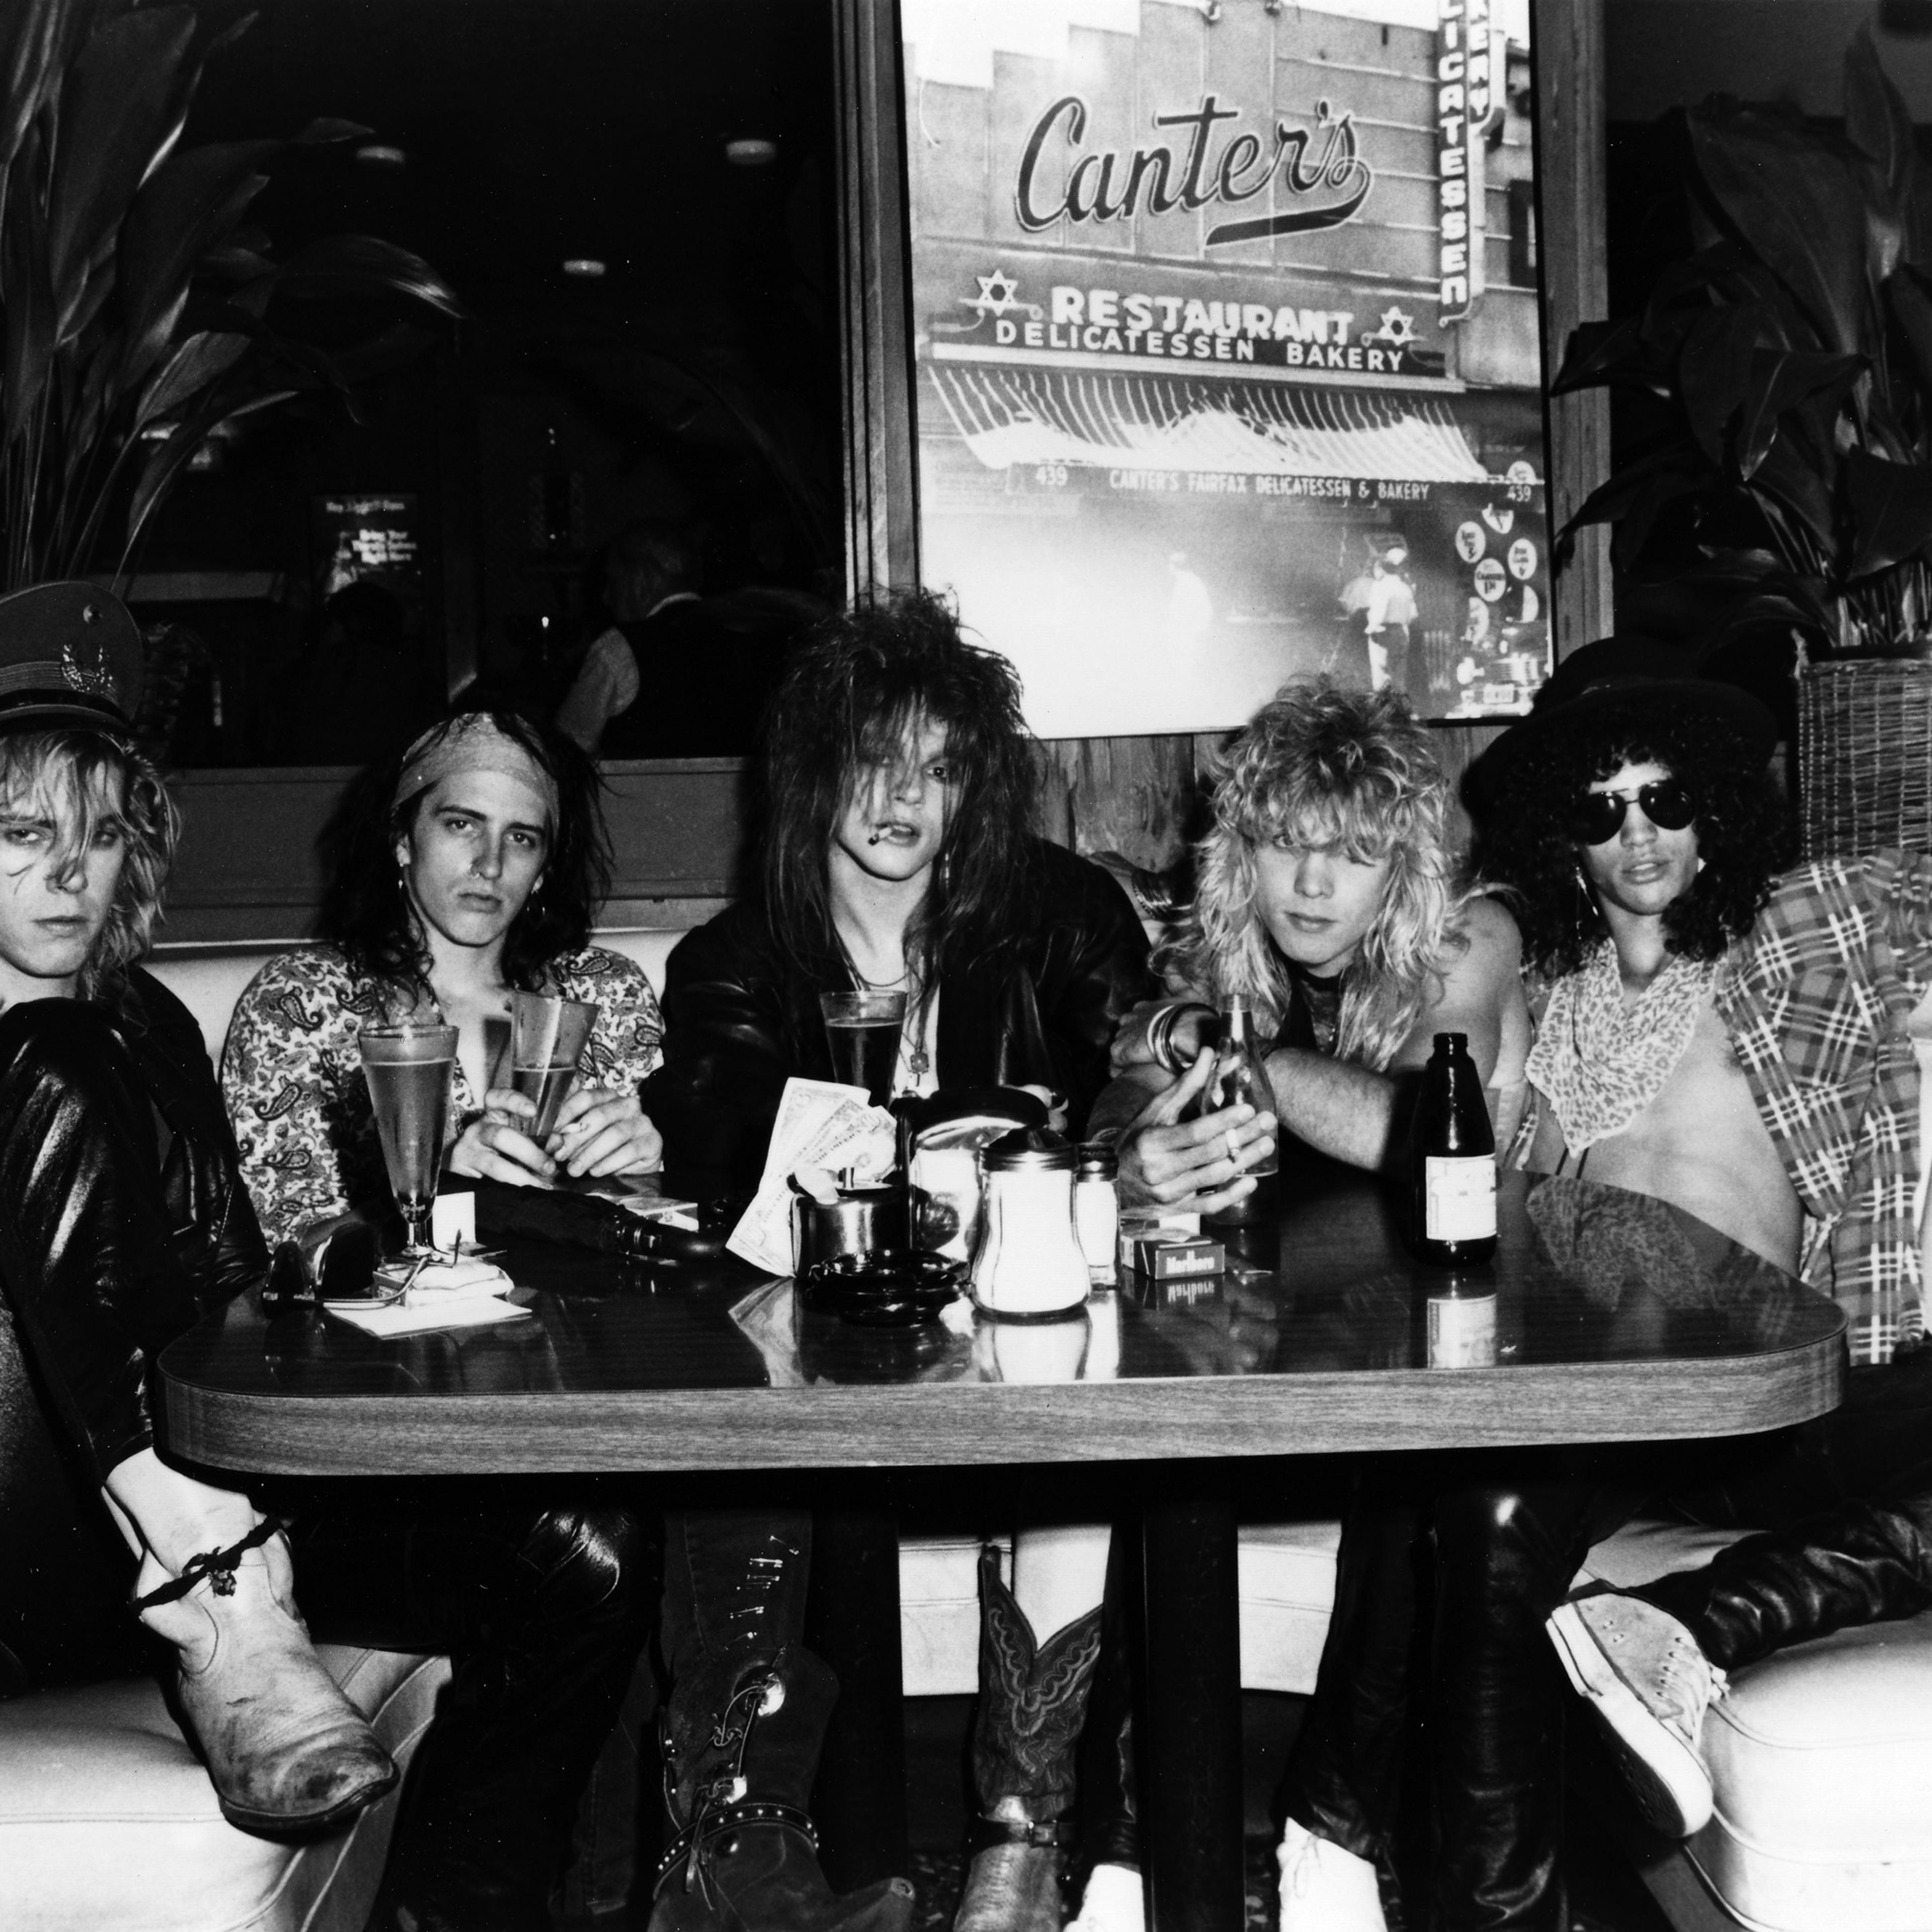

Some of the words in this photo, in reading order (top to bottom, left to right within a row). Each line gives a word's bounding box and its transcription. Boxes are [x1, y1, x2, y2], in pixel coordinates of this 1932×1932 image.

[1014, 96, 1371, 243] Canter's
[1051, 286, 1354, 345] RESTAURANT
[996, 319, 1253, 361] DELICATESSEN
[1286, 342, 1403, 371] BAKERY
[1035, 466, 1068, 486] 439
[1110, 469, 1180, 491] CANTER'S
[1188, 473, 1247, 493] FAIRFAX
[1256, 474, 1351, 497] DELICATESSEN
[1358, 480, 1370, 499] &
[1378, 481, 1429, 501] BAKERY
[1507, 486, 1532, 502] 439
